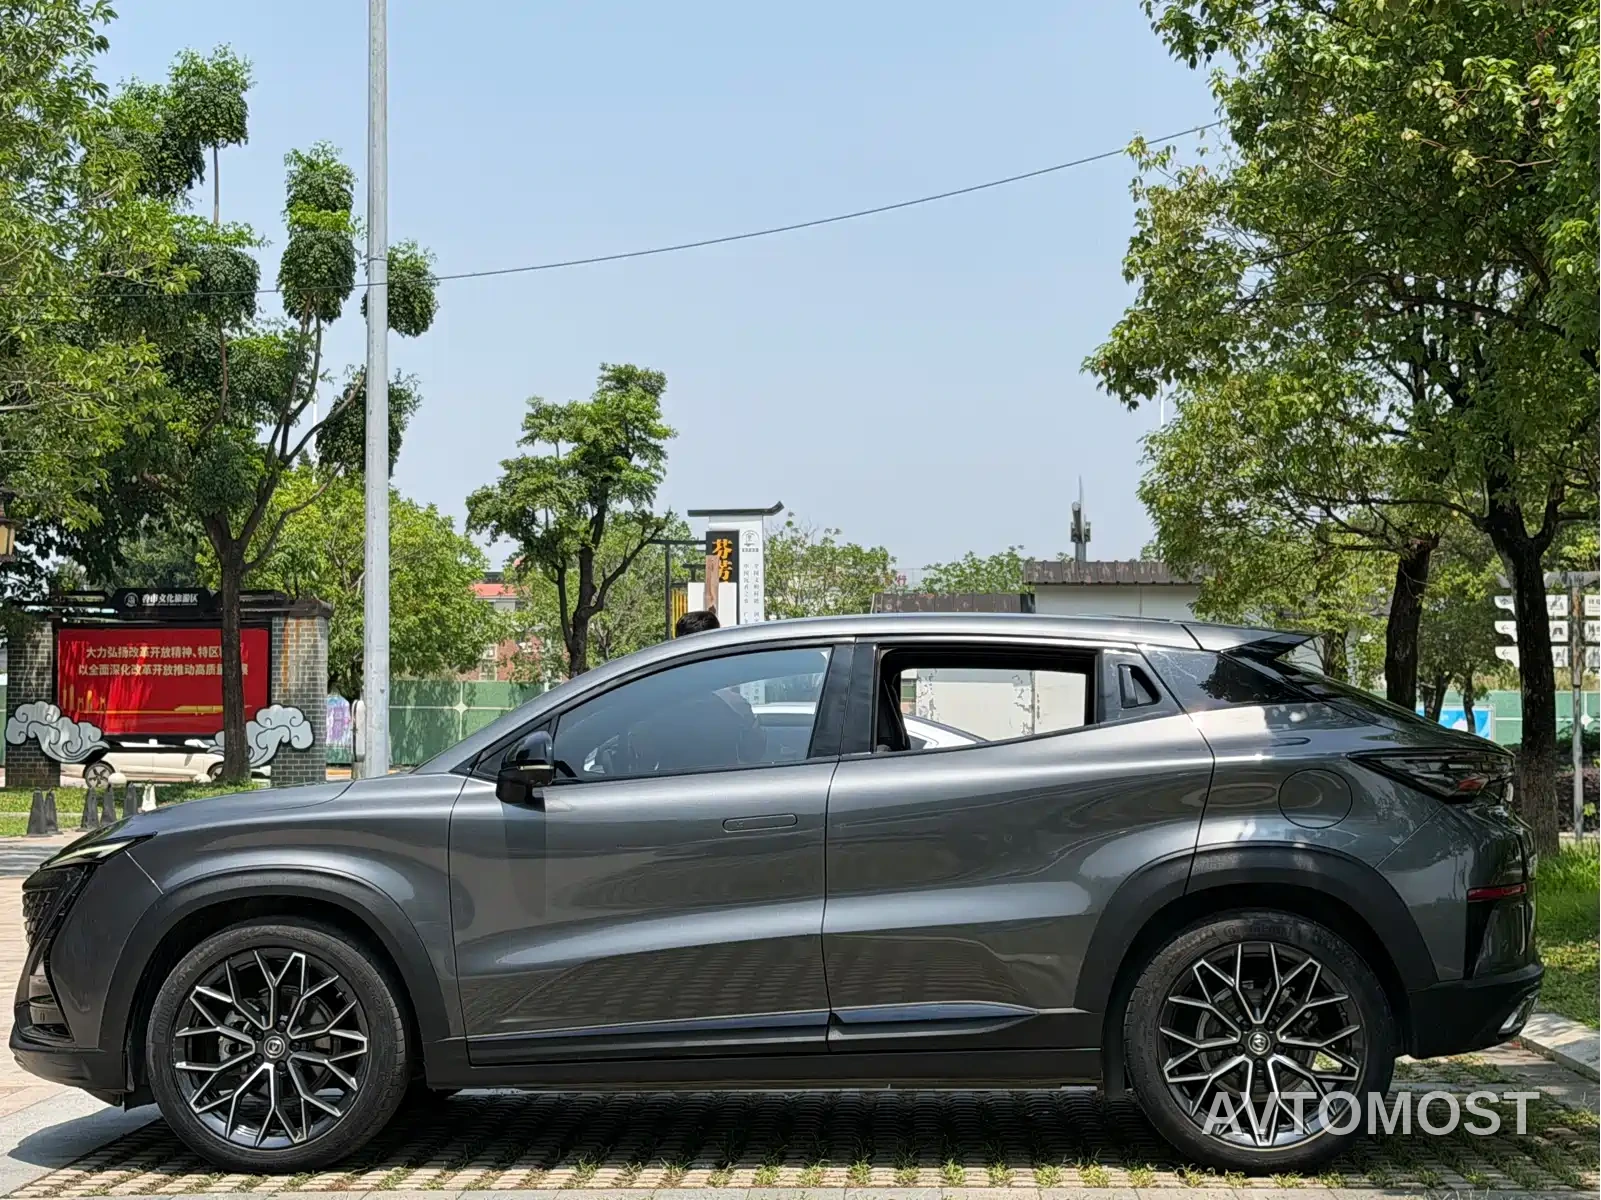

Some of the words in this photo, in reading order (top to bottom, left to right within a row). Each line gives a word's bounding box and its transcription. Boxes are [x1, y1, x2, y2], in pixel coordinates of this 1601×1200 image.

[86, 646, 222, 658] 大力弘扬改革开放精神、特区
[78, 664, 249, 676] 以全面深化改革开放推动高质量展
